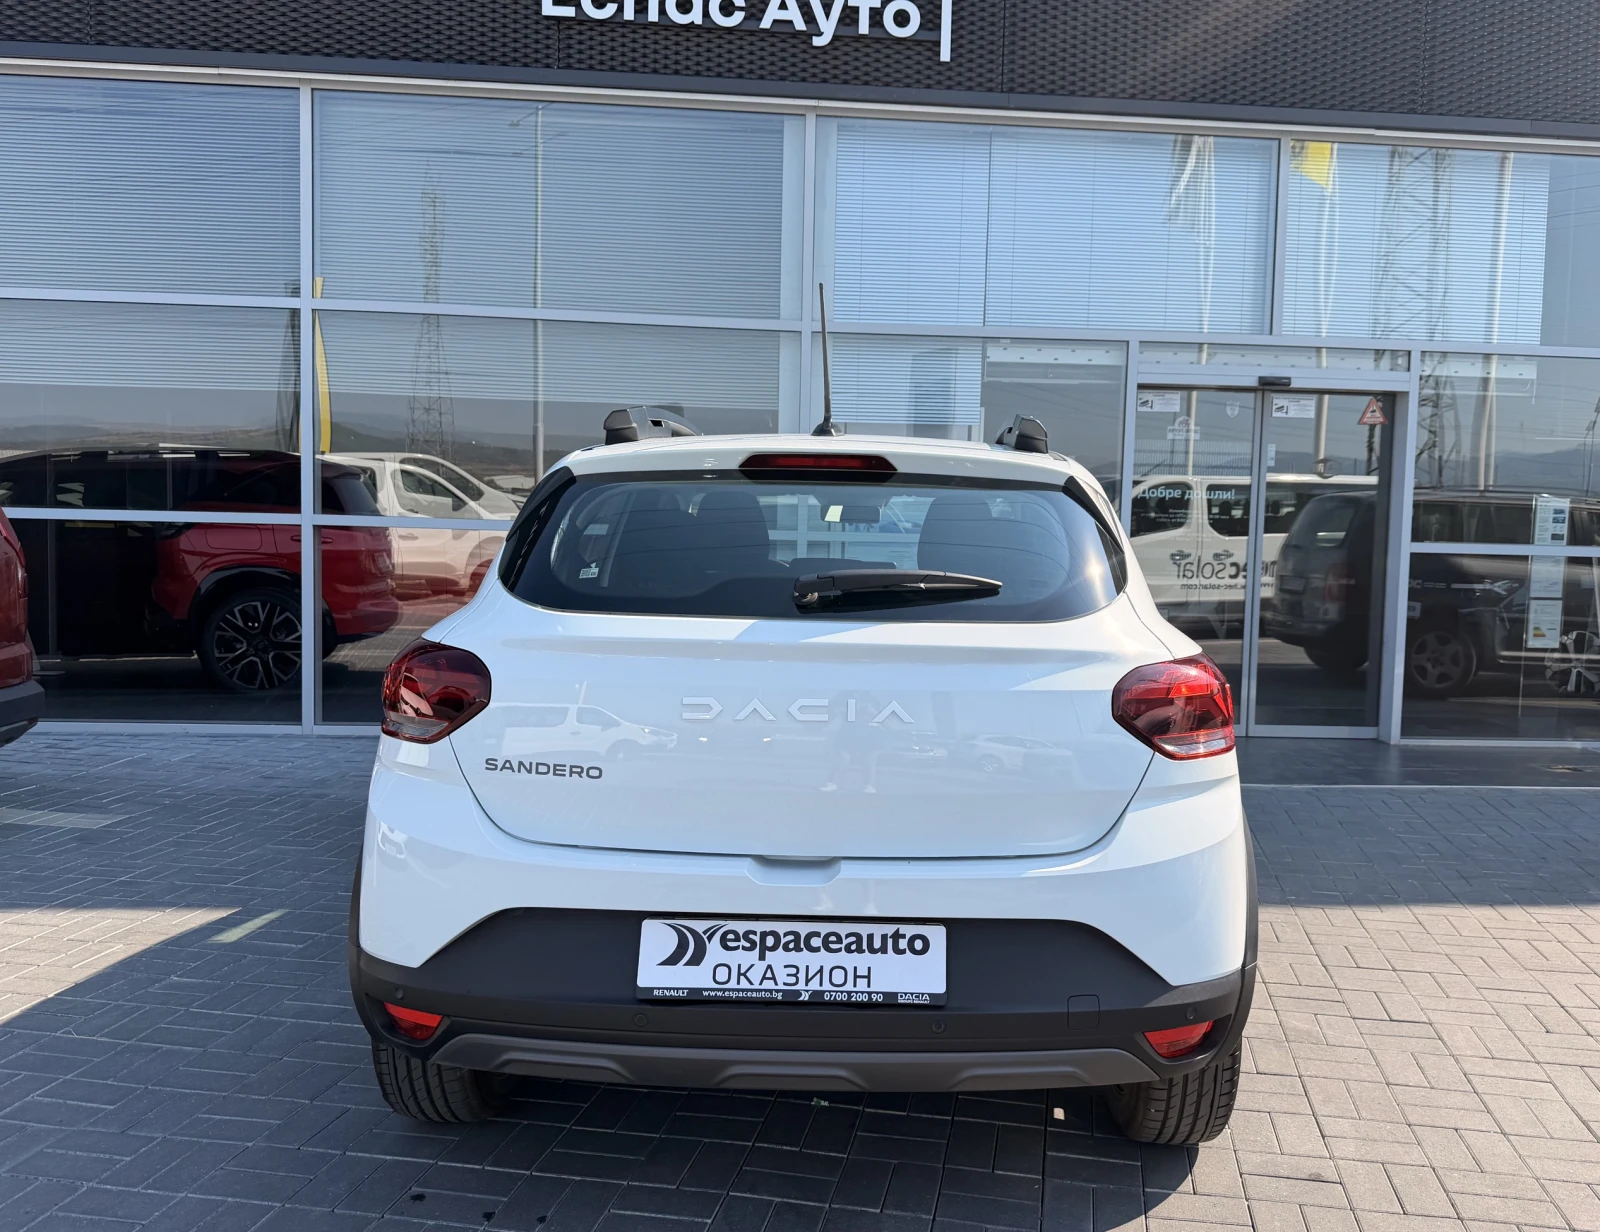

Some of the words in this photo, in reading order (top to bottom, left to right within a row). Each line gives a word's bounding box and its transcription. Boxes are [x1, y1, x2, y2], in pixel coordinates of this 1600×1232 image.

[1138, 486, 1182, 500] Добре
[1185, 488, 1235, 500] дошли!
[682, 697, 915, 723] DACIA
[485, 757, 603, 780] SANDERO
[720, 927, 930, 961] espaceauto
[712, 963, 872, 988] ОКАЗИОН
[653, 989, 689, 997] RENAULT
[702, 990, 783, 999] www.espaceauto.bg
[824, 992, 848, 1001] 0700
[851, 992, 869, 1002] 200
[871, 993, 883, 1002] 90
[897, 993, 930, 1001] DACIA
